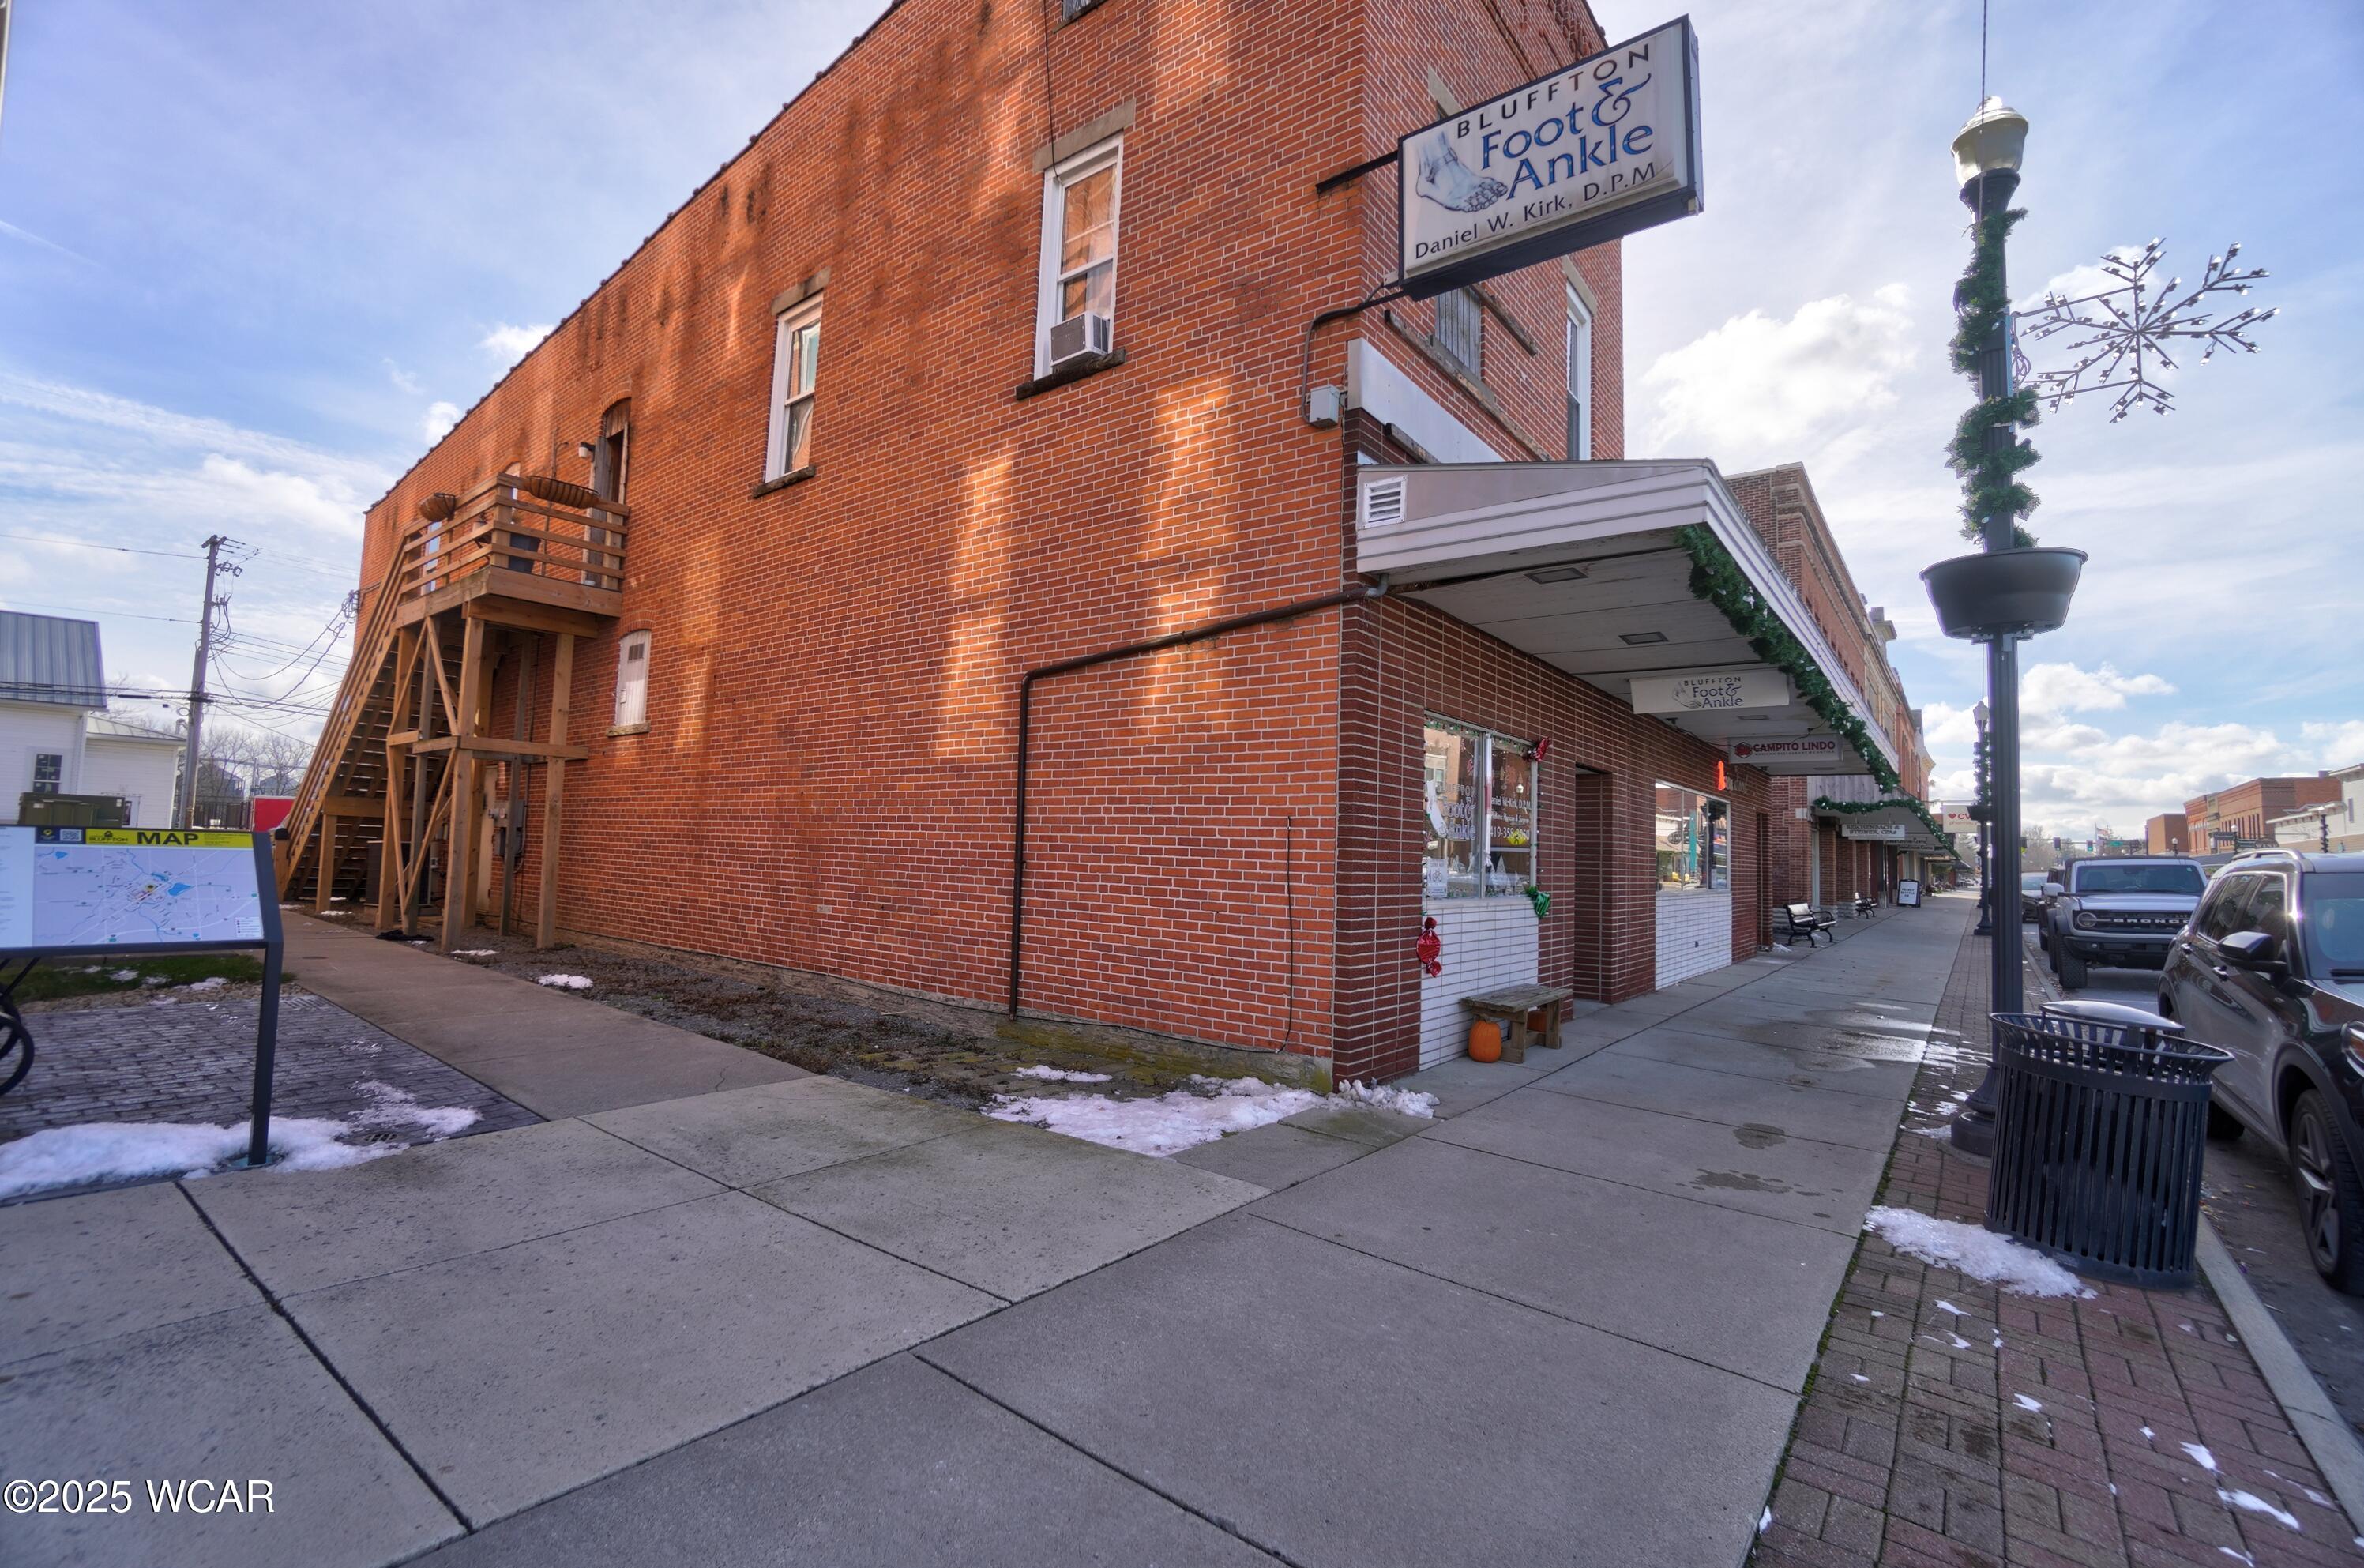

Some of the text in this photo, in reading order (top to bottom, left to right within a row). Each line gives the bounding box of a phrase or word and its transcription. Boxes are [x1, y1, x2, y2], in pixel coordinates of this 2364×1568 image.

[1456, 43, 1650, 139] BLUFFTON
[1481, 73, 1652, 171] Foot &
[1506, 124, 1654, 200] Ankle
[1415, 224, 1478, 259] Daniel
[1487, 214, 1513, 232] W.
[1523, 195, 1573, 223] Kirk,
[1684, 676, 1741, 686] BLUFFTON
[1693, 683, 1742, 698] Foot &
[1701, 696, 1744, 709] Ankle
[1753, 741, 1836, 752] CAMPITO LINDO
[137, 831, 199, 845] MAP
